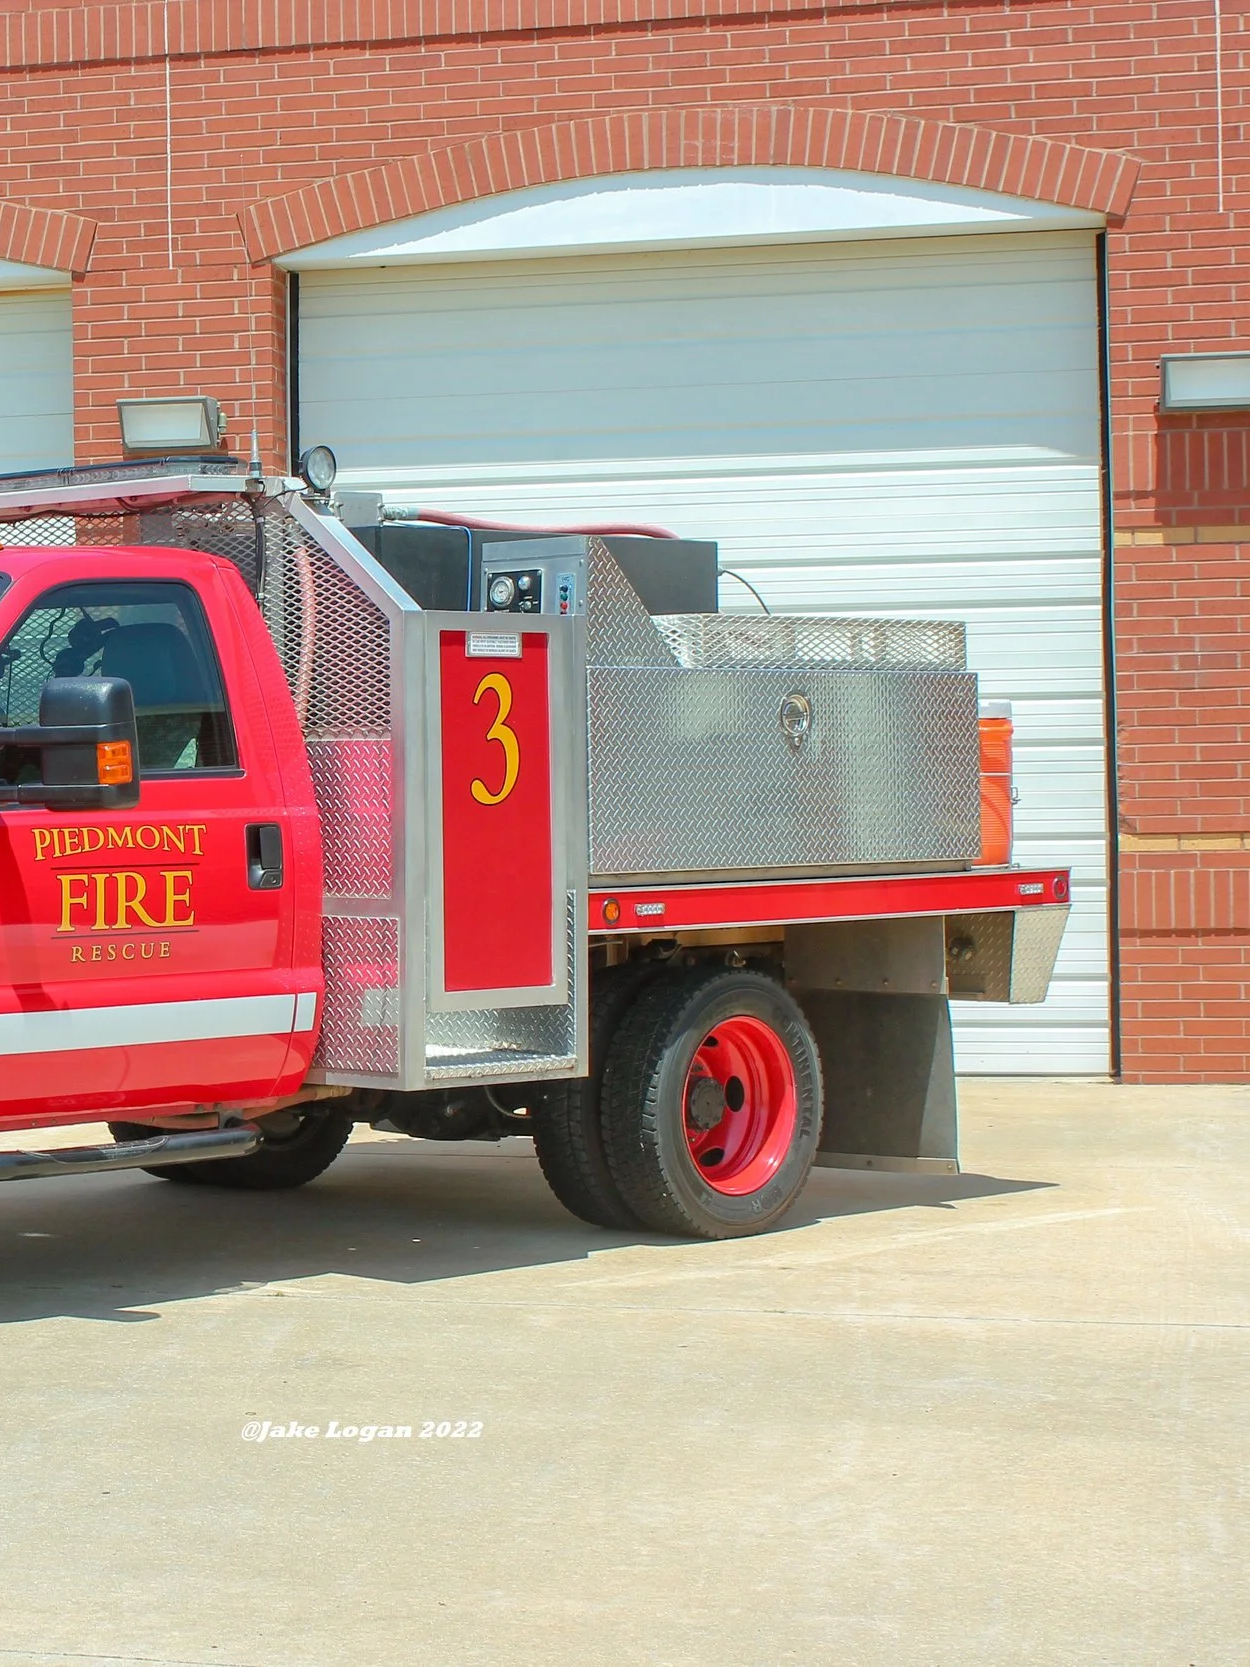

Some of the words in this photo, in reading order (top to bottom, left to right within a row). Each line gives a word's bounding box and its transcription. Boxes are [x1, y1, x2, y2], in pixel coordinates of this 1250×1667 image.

[470, 671, 520, 806] 3
[31, 824, 208, 861] PIEDMONT
[56, 870, 196, 933] FIRE
[70, 941, 172, 963] RESCUE
